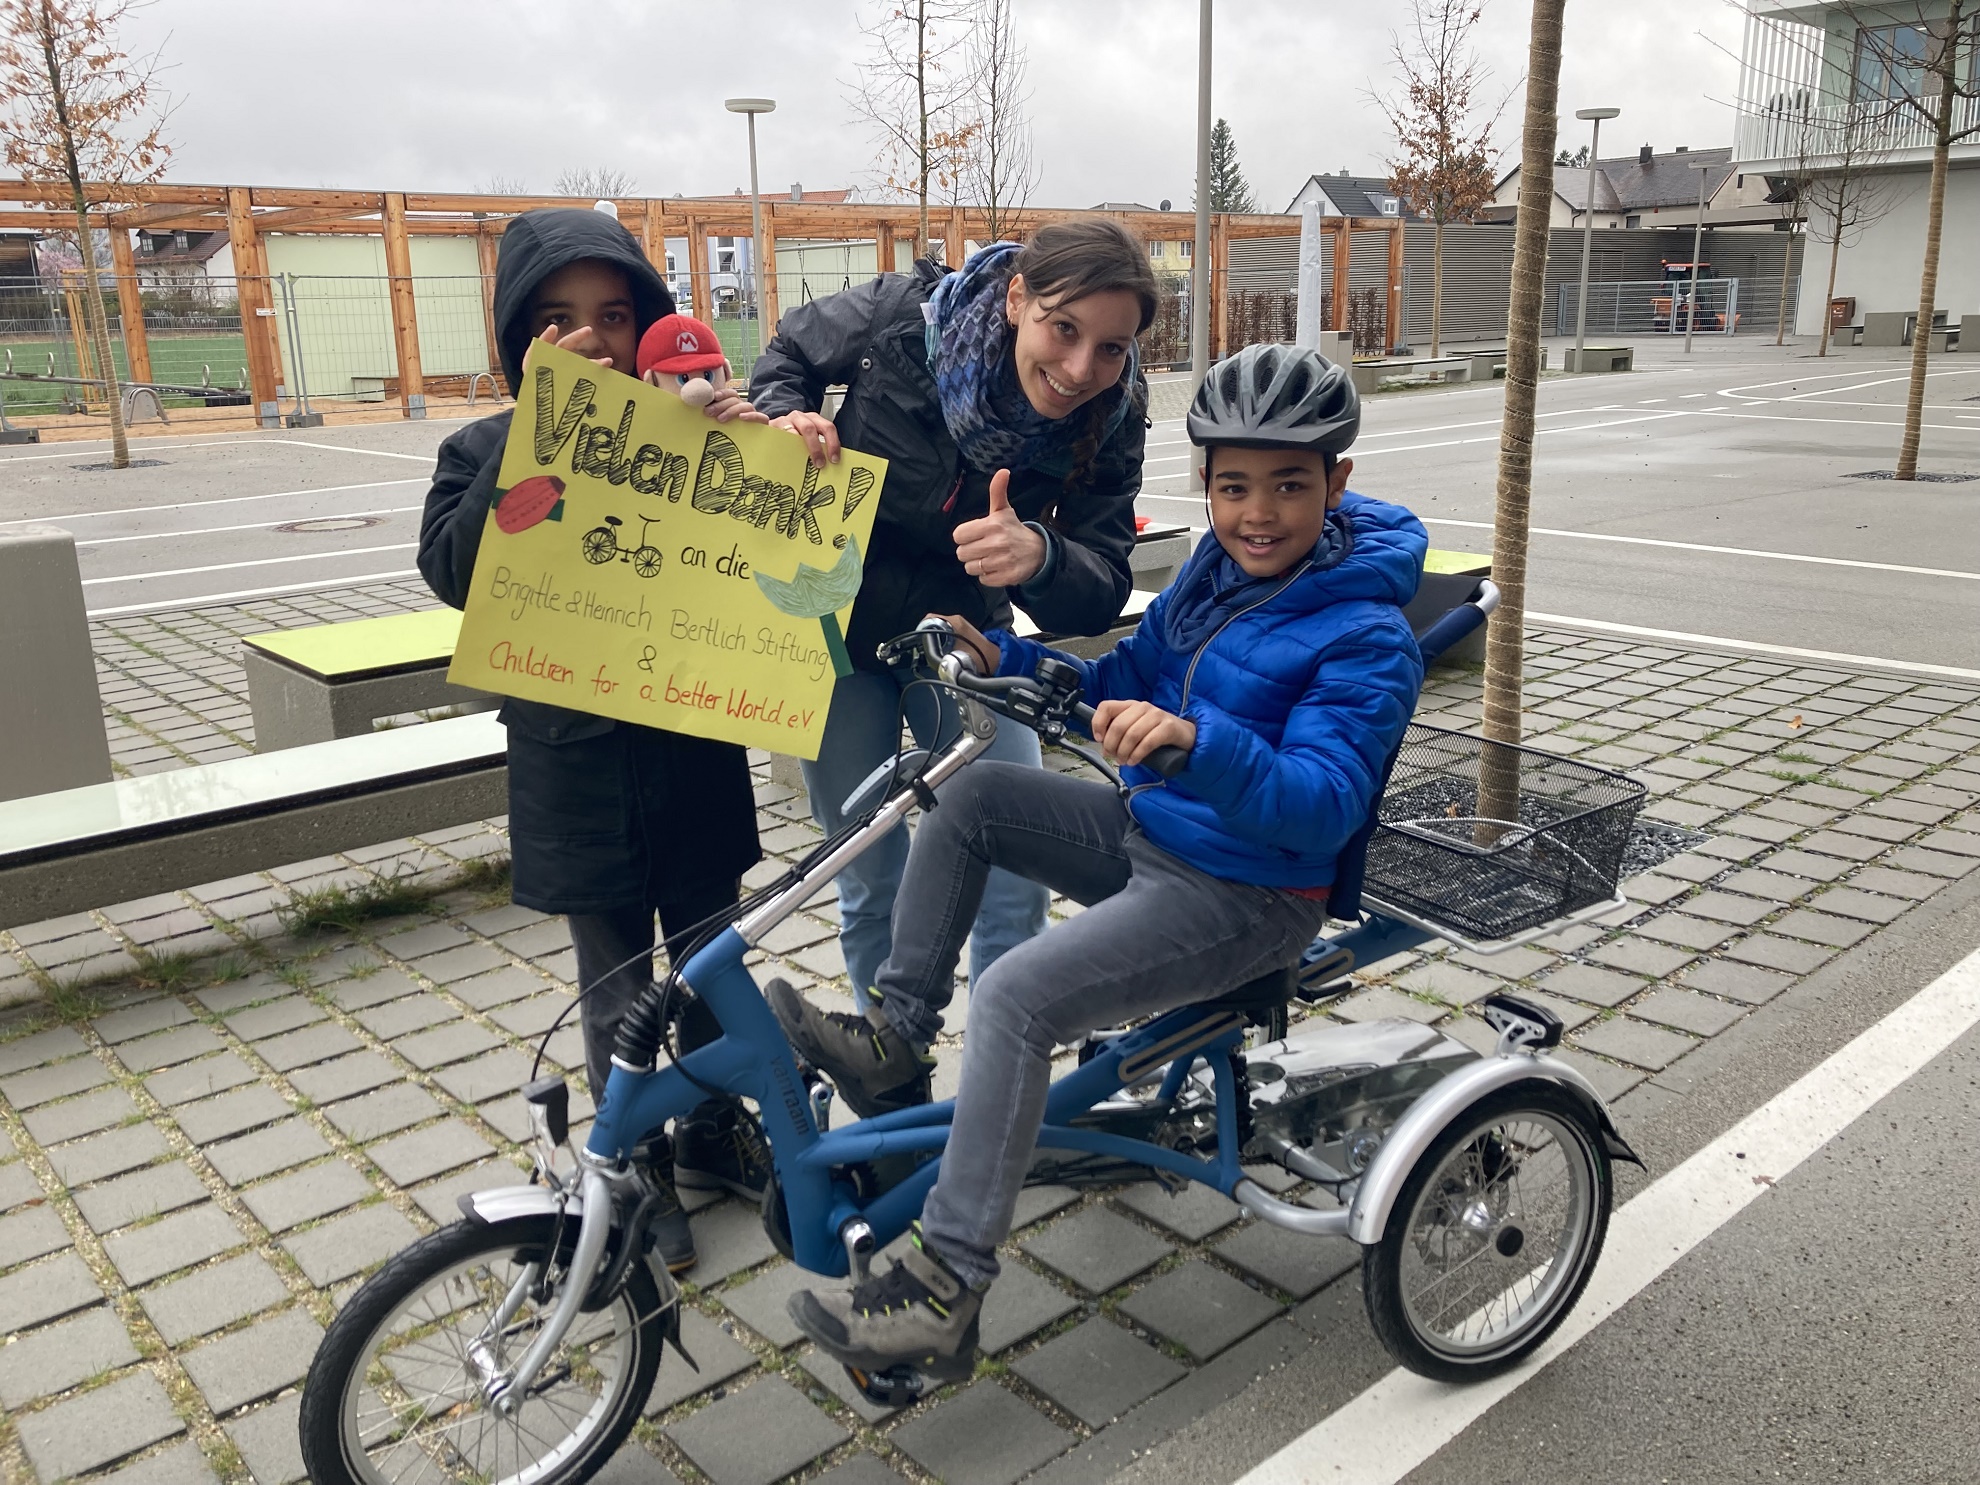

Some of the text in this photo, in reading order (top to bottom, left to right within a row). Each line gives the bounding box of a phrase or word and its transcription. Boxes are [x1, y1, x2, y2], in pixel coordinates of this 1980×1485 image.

[679, 333, 698, 351] M
[535, 366, 875, 551] Vielen Dank!
[680, 542, 751, 580] an die
[490, 566, 561, 621] Brigitte
[583, 590, 652, 632] Heinrich
[670, 608, 746, 651] Bertlich
[752, 627, 830, 682] Stiftung
[489, 641, 574, 685] Children
[590, 664, 620, 697] for
[639, 684, 657, 702] a
[664, 673, 723, 710] better
[726, 687, 785, 725] World
[637, 645, 657, 674] &
